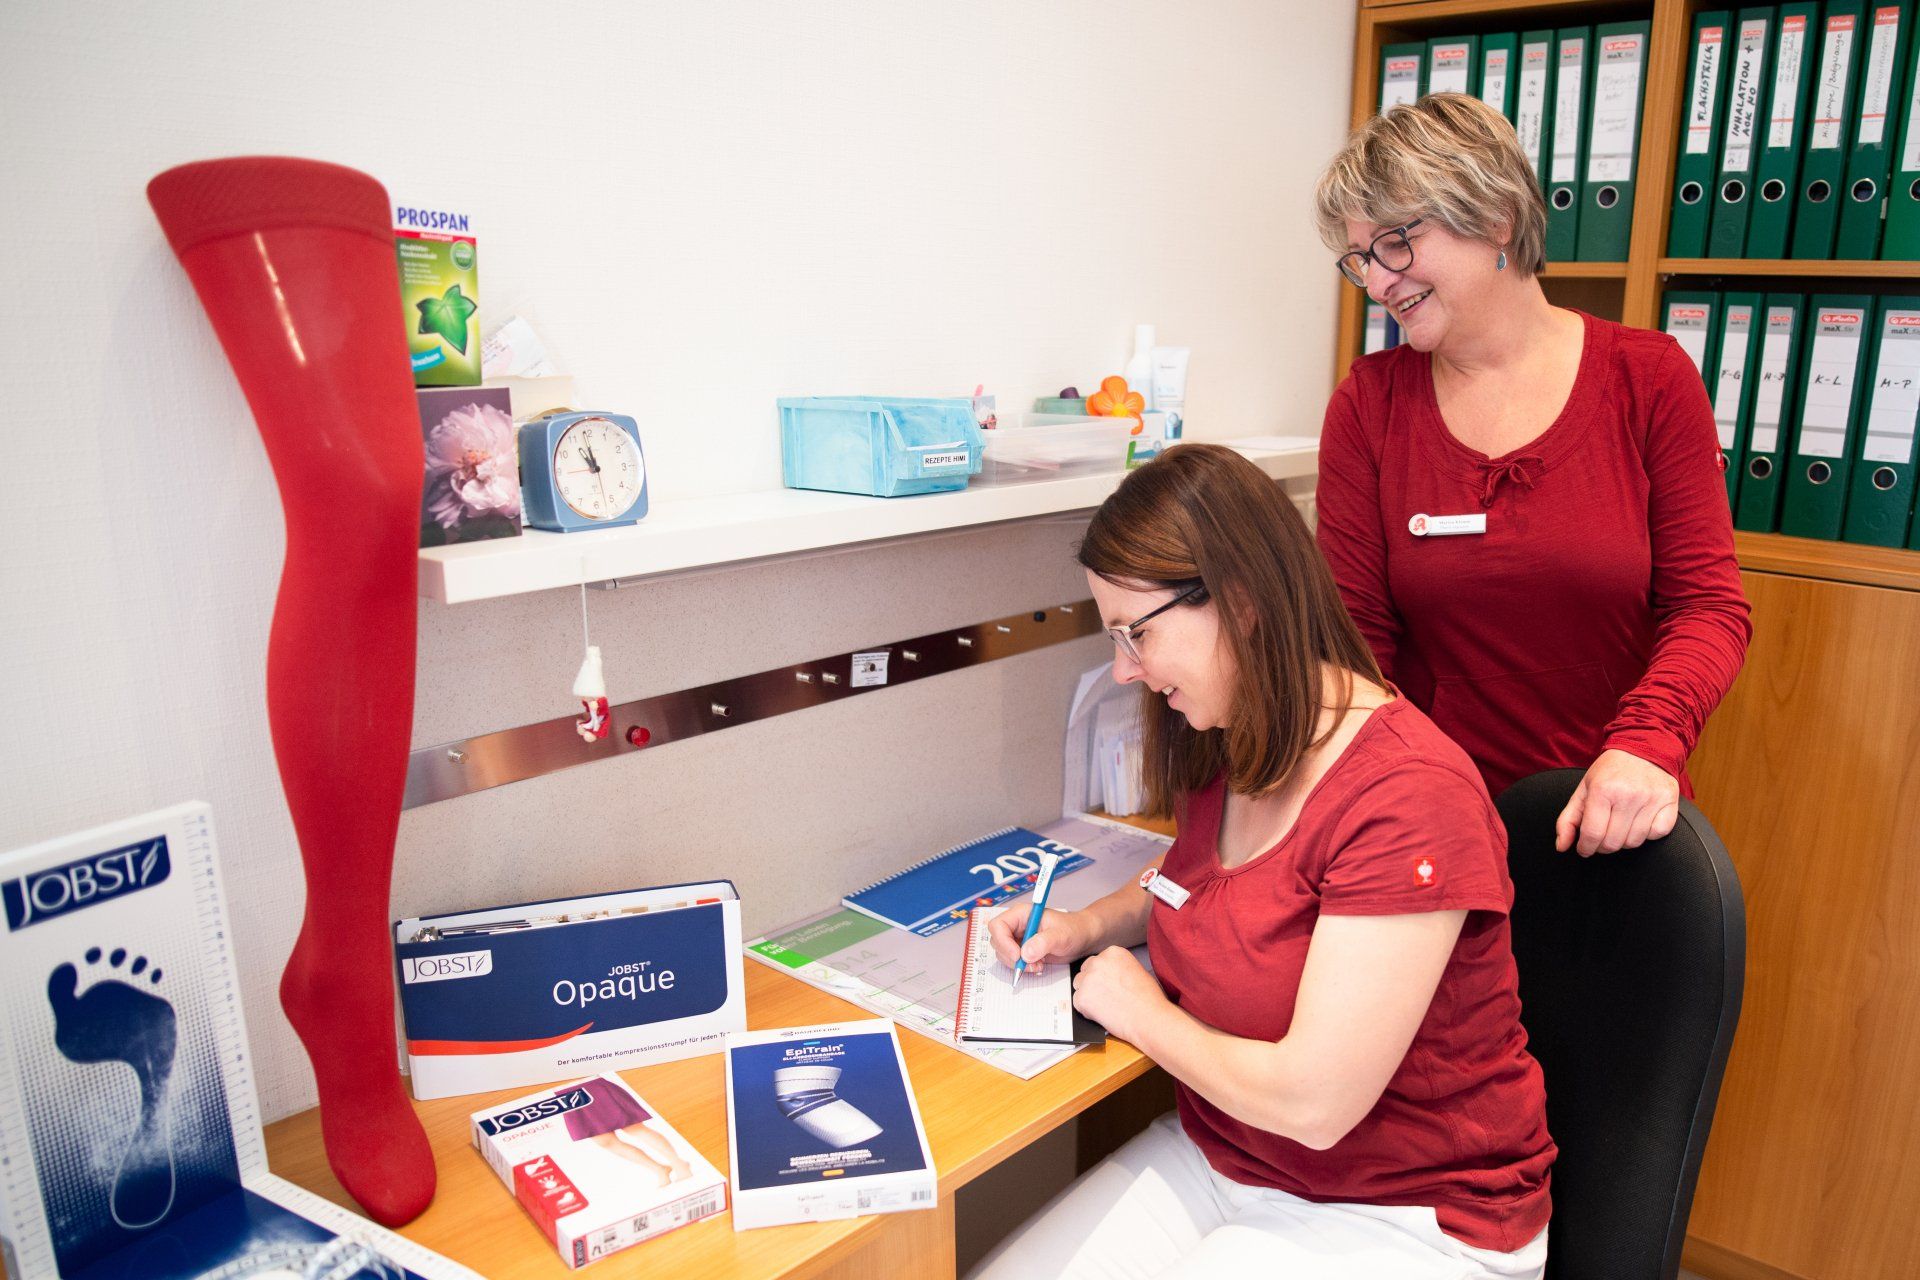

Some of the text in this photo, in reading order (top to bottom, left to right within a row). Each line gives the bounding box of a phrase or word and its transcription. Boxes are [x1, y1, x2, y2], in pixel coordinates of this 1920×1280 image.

[1697, 44, 1714, 121] FLACHSTRICK
[1731, 60, 1750, 137] INHALATION
[1742, 110, 1753, 137] AOK
[397, 206, 469, 232] PROSPAN
[560, 449, 569, 459] 10
[615, 445, 621, 454] 2
[925, 455, 952, 464] REZEPTE
[621, 462, 627, 471] 3
[577, 497, 583, 506] 7
[593, 500, 599, 510] 6
[609, 494, 615, 503] 5
[969, 839, 1082, 886] 2023
[19, 848, 141, 926] JOBST
[411, 954, 476, 982] JOBST
[553, 969, 676, 1008] Opaque
[571, 1052, 613, 1063] komfortable
[614, 1038, 687, 1057] Kompressionsstrumpf
[700, 1033, 718, 1042] jeden
[488, 1095, 568, 1135] JOBST
[502, 1121, 554, 1142] OPAQUE
